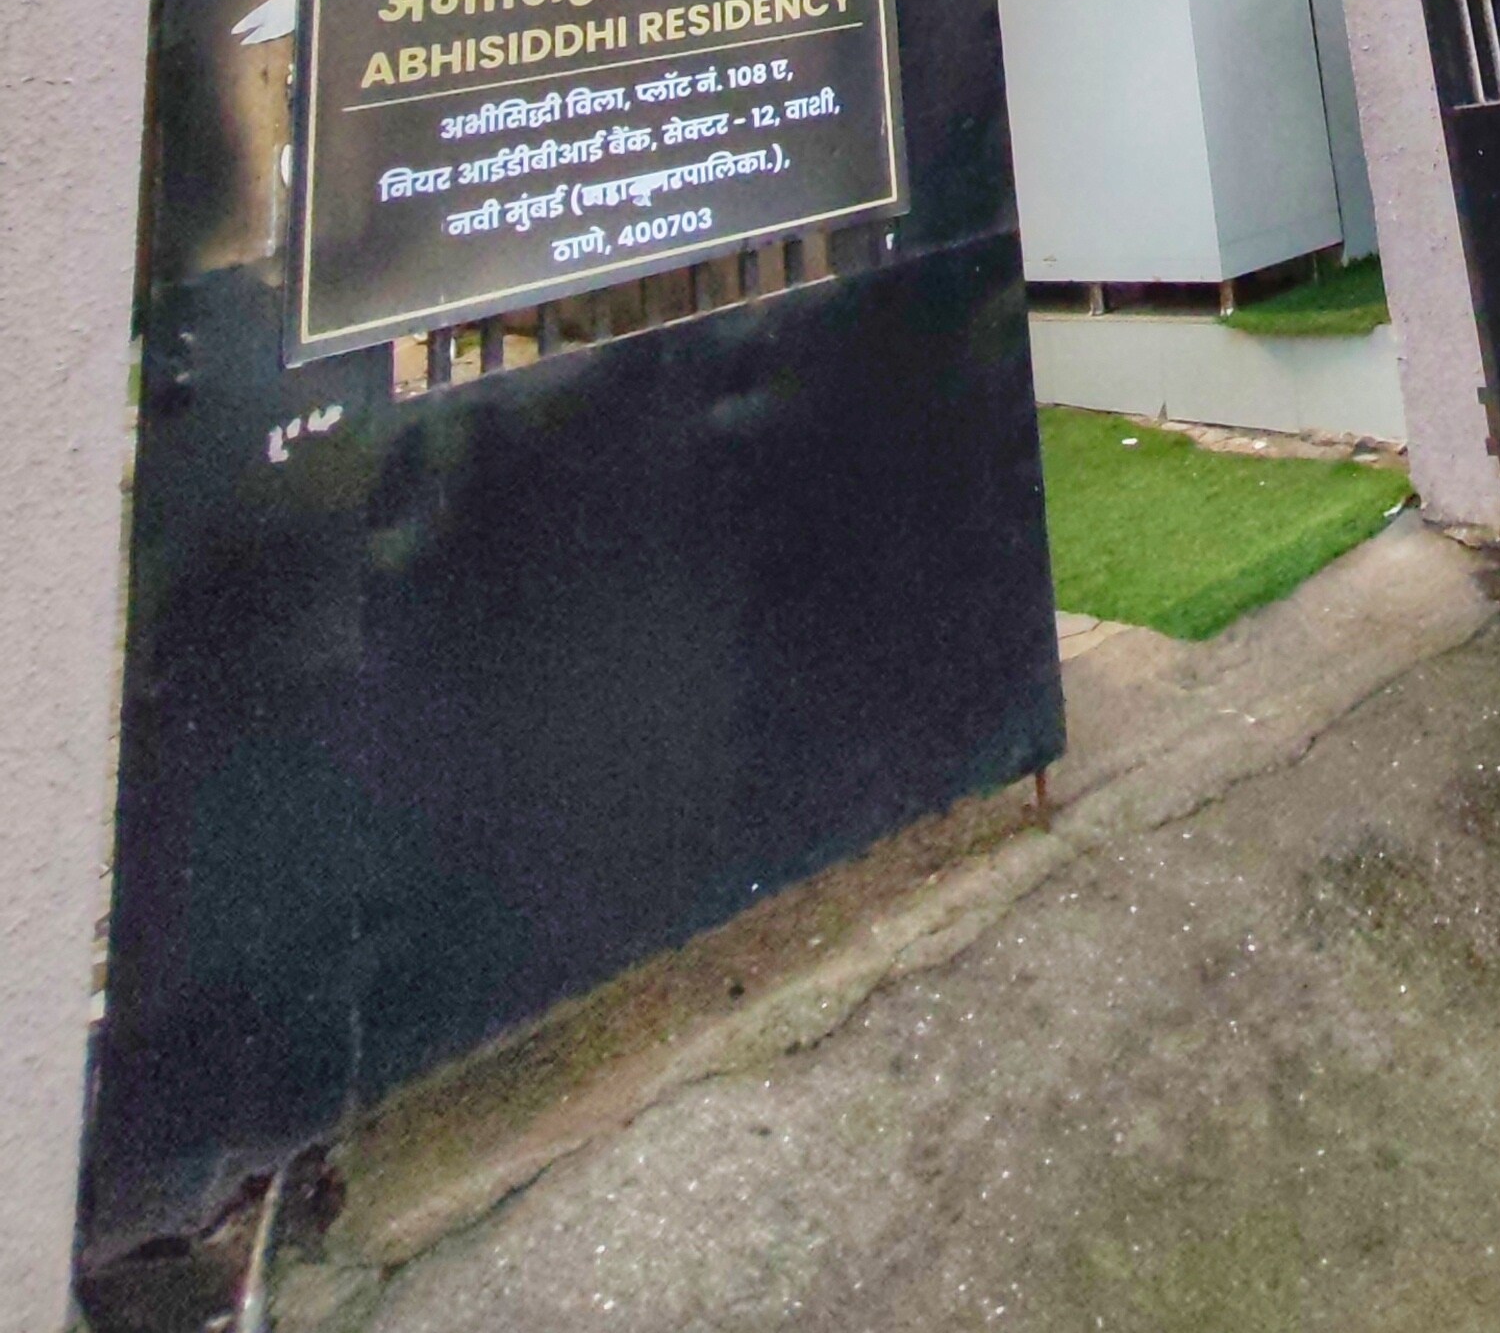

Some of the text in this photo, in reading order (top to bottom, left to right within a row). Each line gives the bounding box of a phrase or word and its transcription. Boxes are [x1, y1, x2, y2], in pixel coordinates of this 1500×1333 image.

[361, 15, 627, 89] ABHISIDDHI
[566, 87, 631, 119] विला,
[635, 71, 693, 102] प्लॉट
[695, 66, 723, 93] नं.
[727, 63, 767, 89] 108
[770, 59, 794, 82] ए,
[379, 167, 453, 203] नियर
[457, 130, 607, 184] आईडीबीआई
[608, 125, 657, 155] बैंक,
[662, 113, 729, 145] सेक्टर
[752, 105, 781, 128] 12,
[784, 86, 841, 119] वाशी,
[446, 199, 501, 236] नवी
[504, 184, 569, 232] मुंबई
[552, 208, 713, 263] ठाणे, 400703
